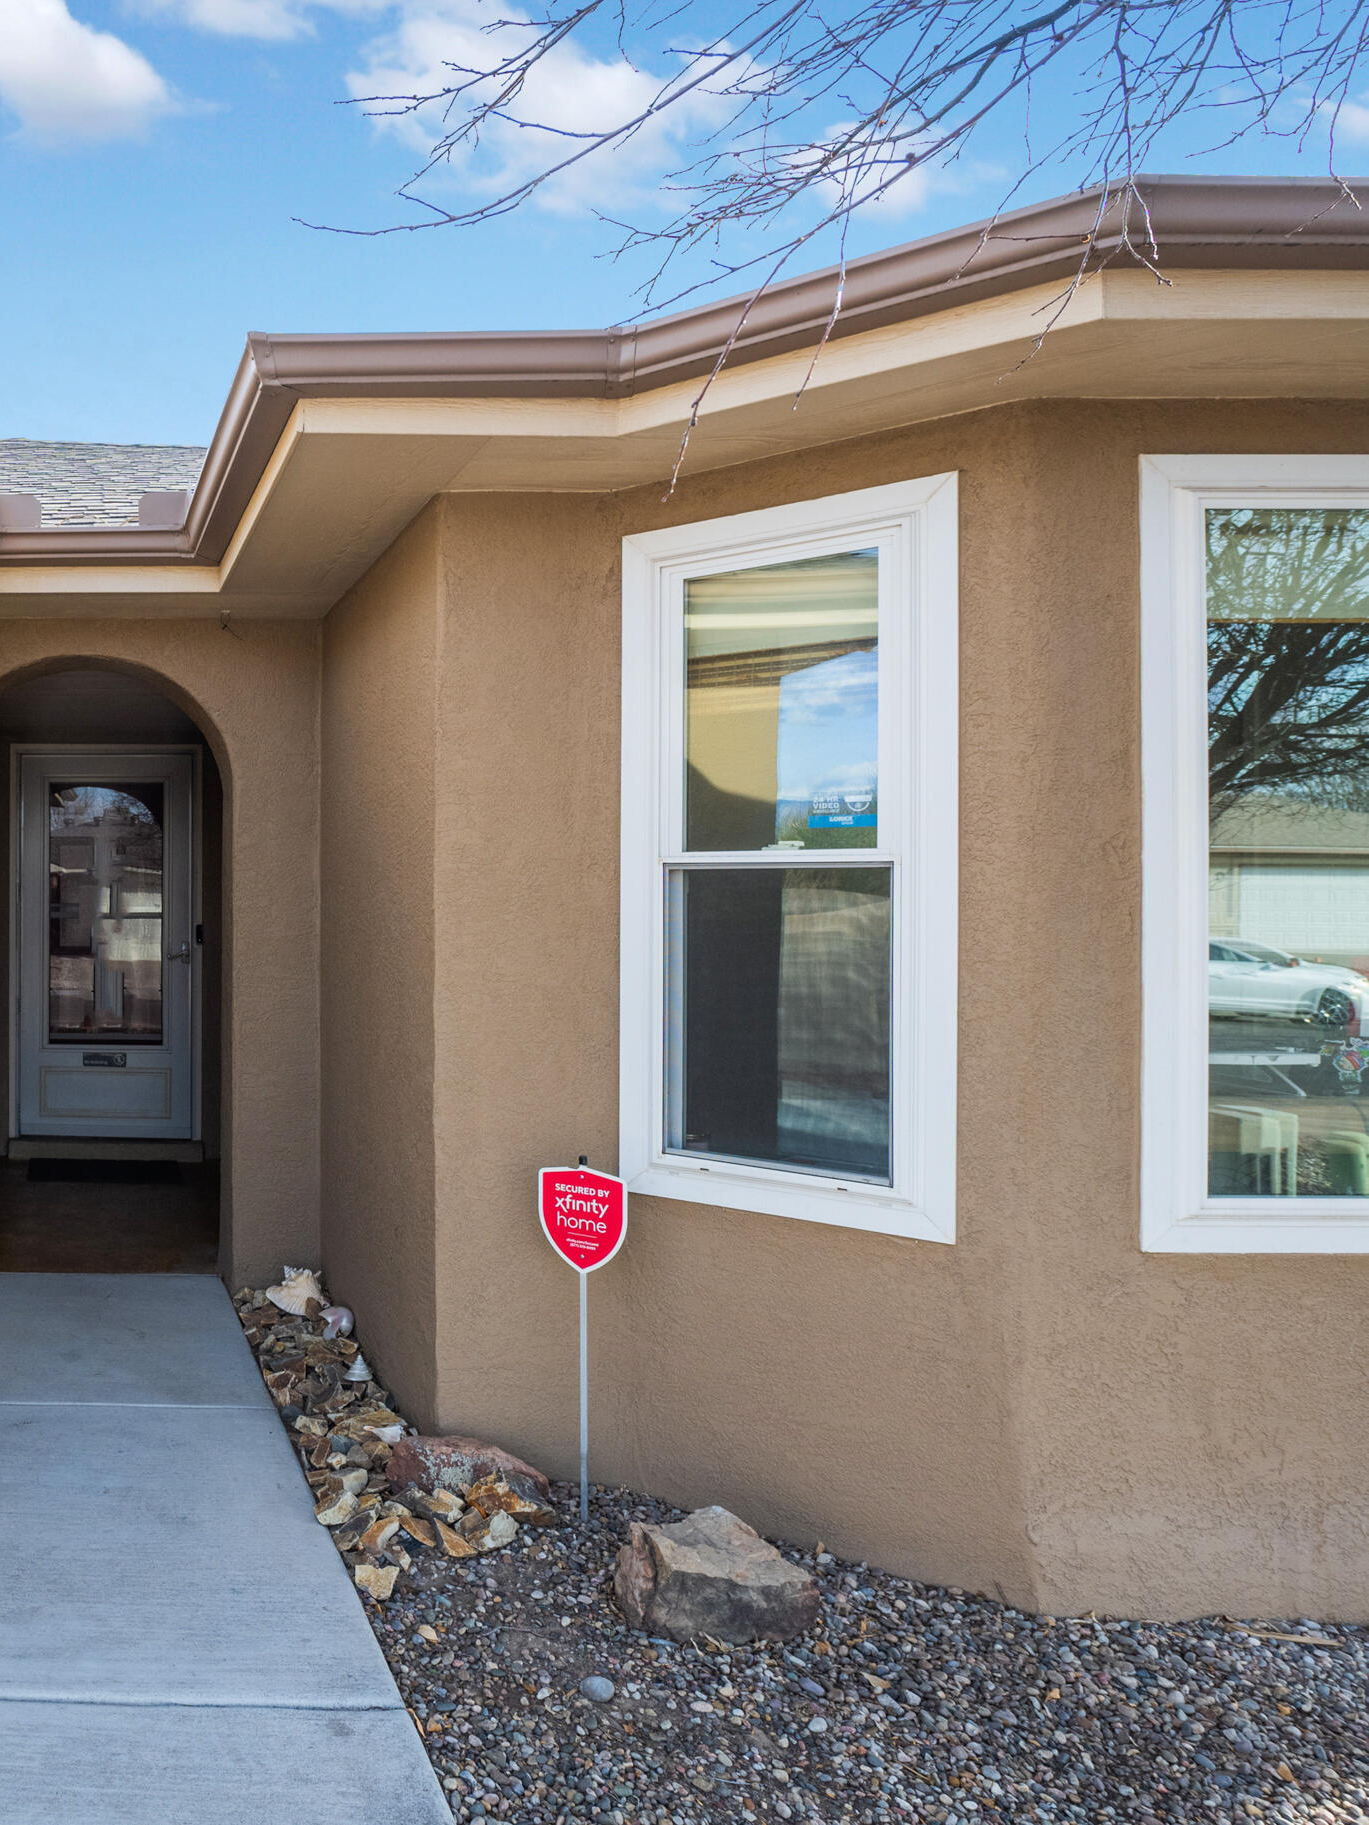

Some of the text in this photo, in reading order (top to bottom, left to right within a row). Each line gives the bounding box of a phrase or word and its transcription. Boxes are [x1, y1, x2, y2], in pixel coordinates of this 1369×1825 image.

[555, 1183, 610, 1197] SECURED BY
[555, 1194, 609, 1218] xfinity
[557, 1211, 607, 1233] home
